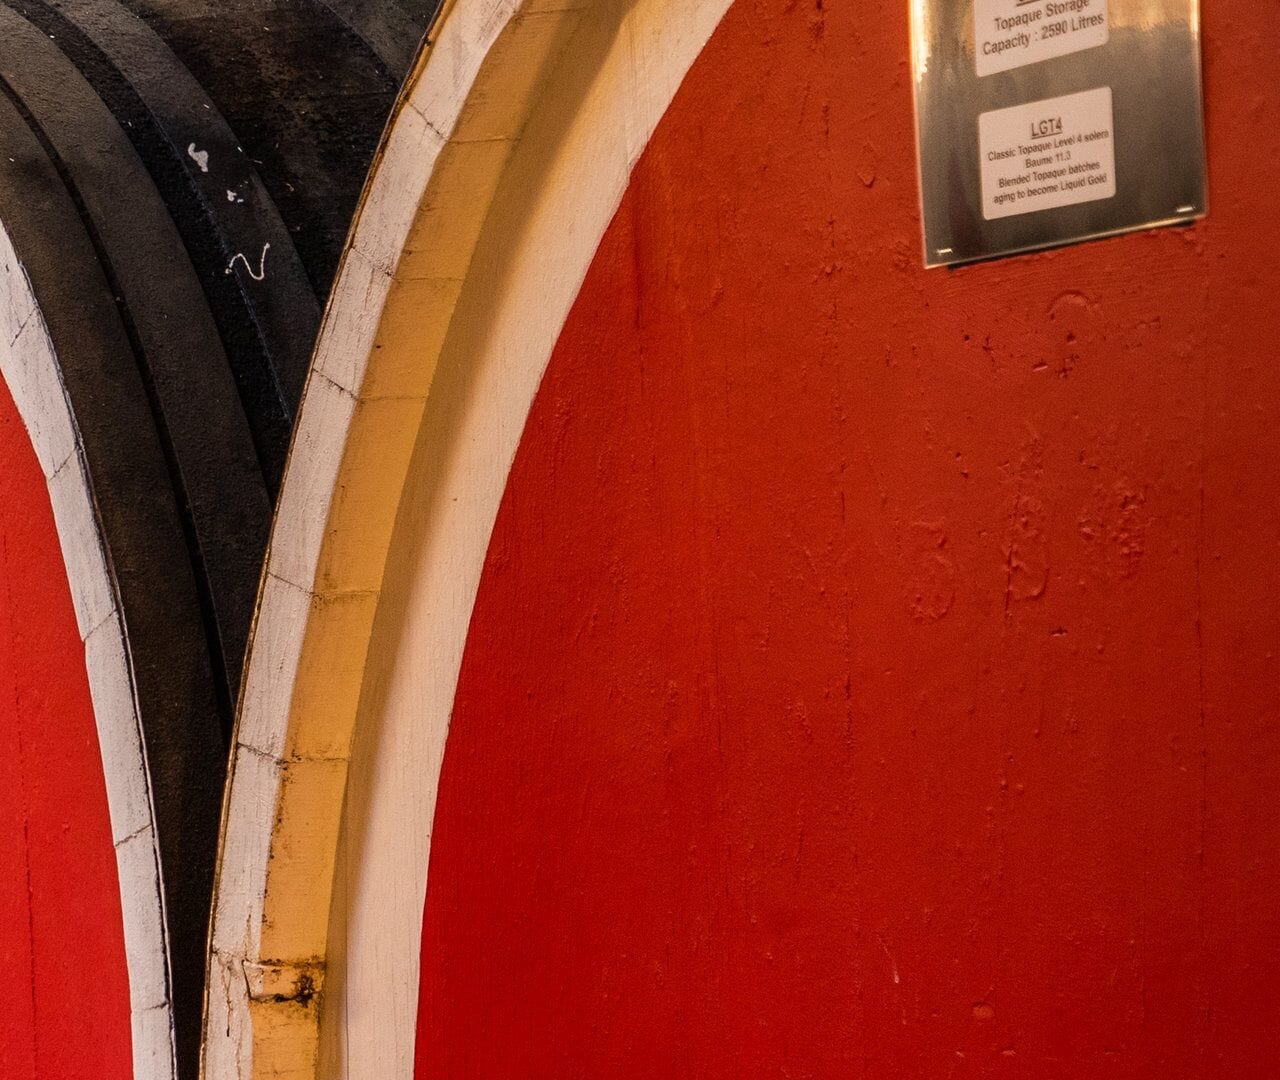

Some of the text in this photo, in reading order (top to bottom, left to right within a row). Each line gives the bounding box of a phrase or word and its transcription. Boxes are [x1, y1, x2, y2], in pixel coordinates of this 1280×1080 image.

[994, 0, 1090, 31] Topaque Storage
[983, 33, 1031, 55] Capacity
[1041, 20, 1068, 40] 2590
[1071, 13, 1105, 31] Litres
[1031, 117, 1063, 138] LGT4
[988, 148, 1016, 161] Classic
[1018, 142, 1052, 156] Topaque
[1054, 135, 1075, 148] Level
[1025, 156, 1053, 168] Baume
[993, 172, 1108, 205] aging to become Liquid Gold
[998, 161, 1101, 189] Blended Topaque batches
